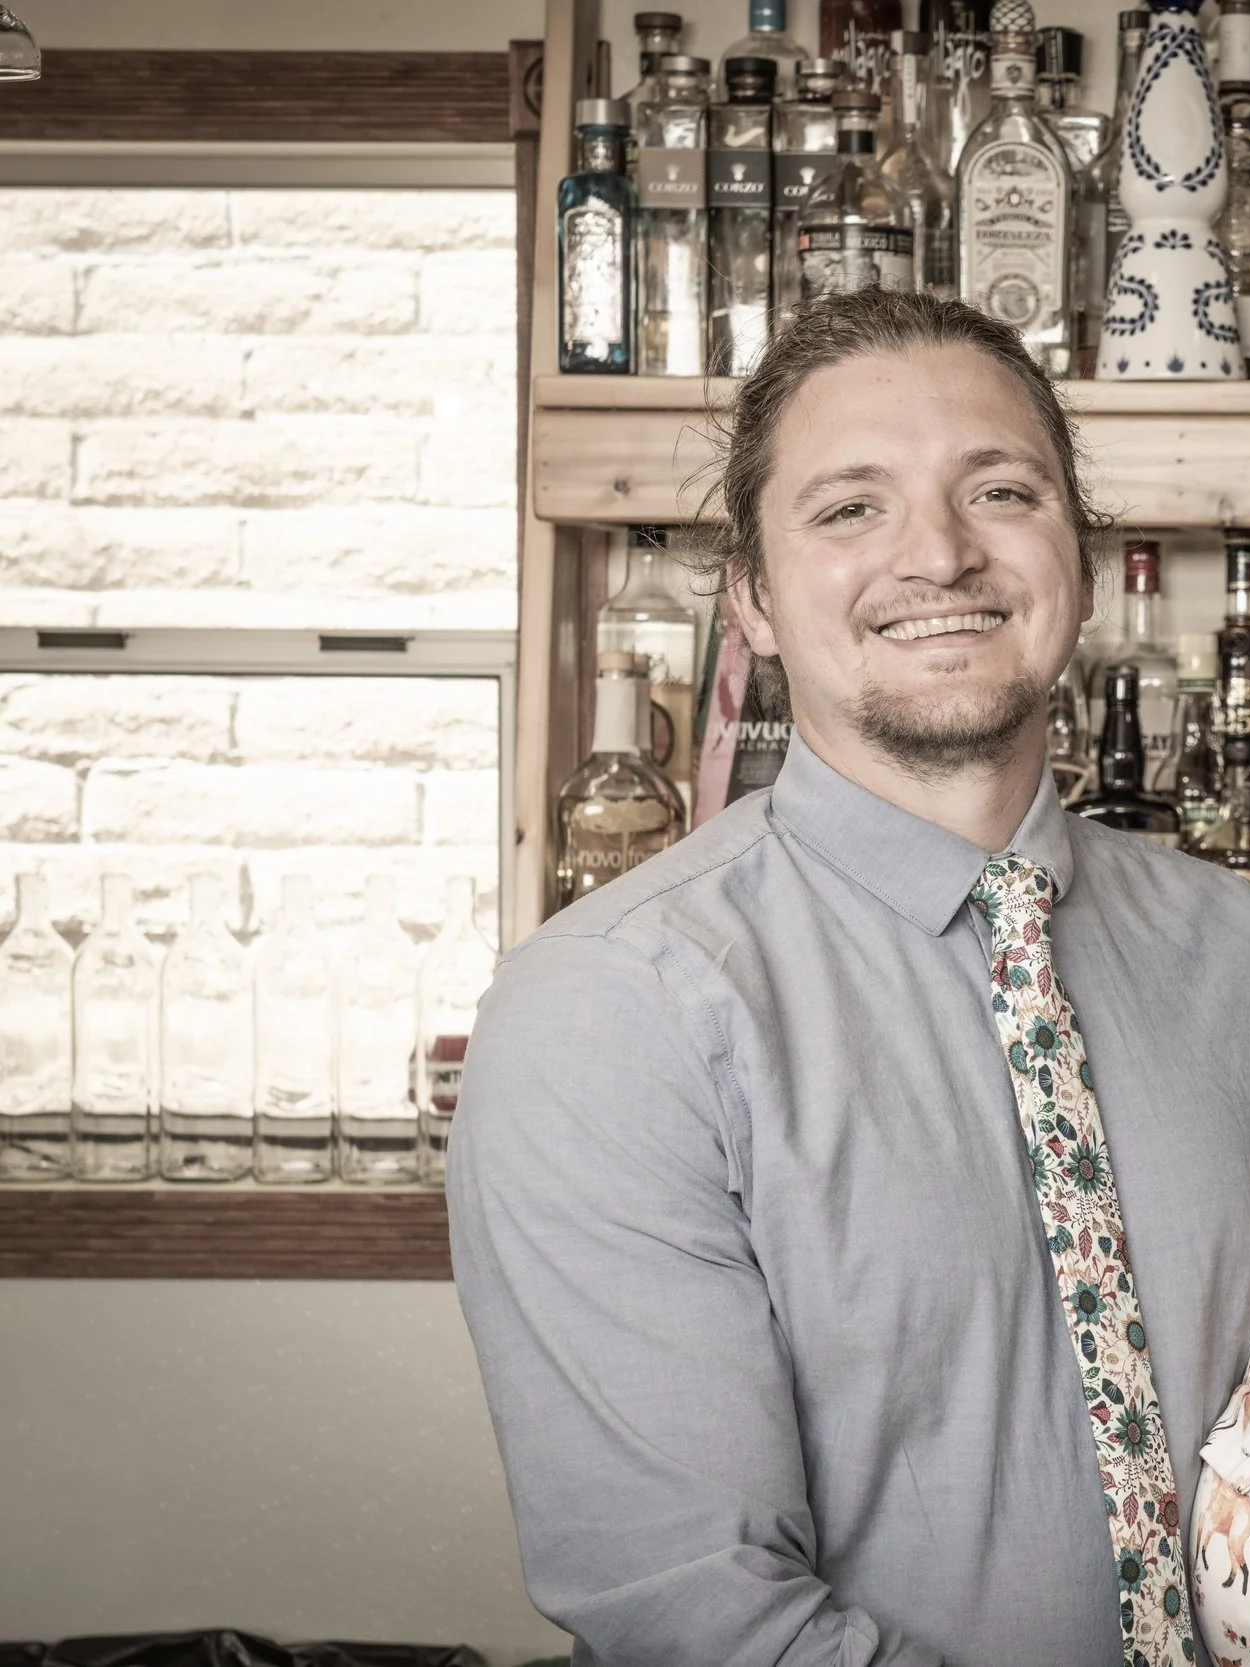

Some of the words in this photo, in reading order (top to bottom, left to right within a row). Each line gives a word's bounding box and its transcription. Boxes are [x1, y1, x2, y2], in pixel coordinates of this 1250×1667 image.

[647, 182, 699, 194] CORZO
[714, 182, 765, 194] CORZO
[577, 850, 621, 869] novo
